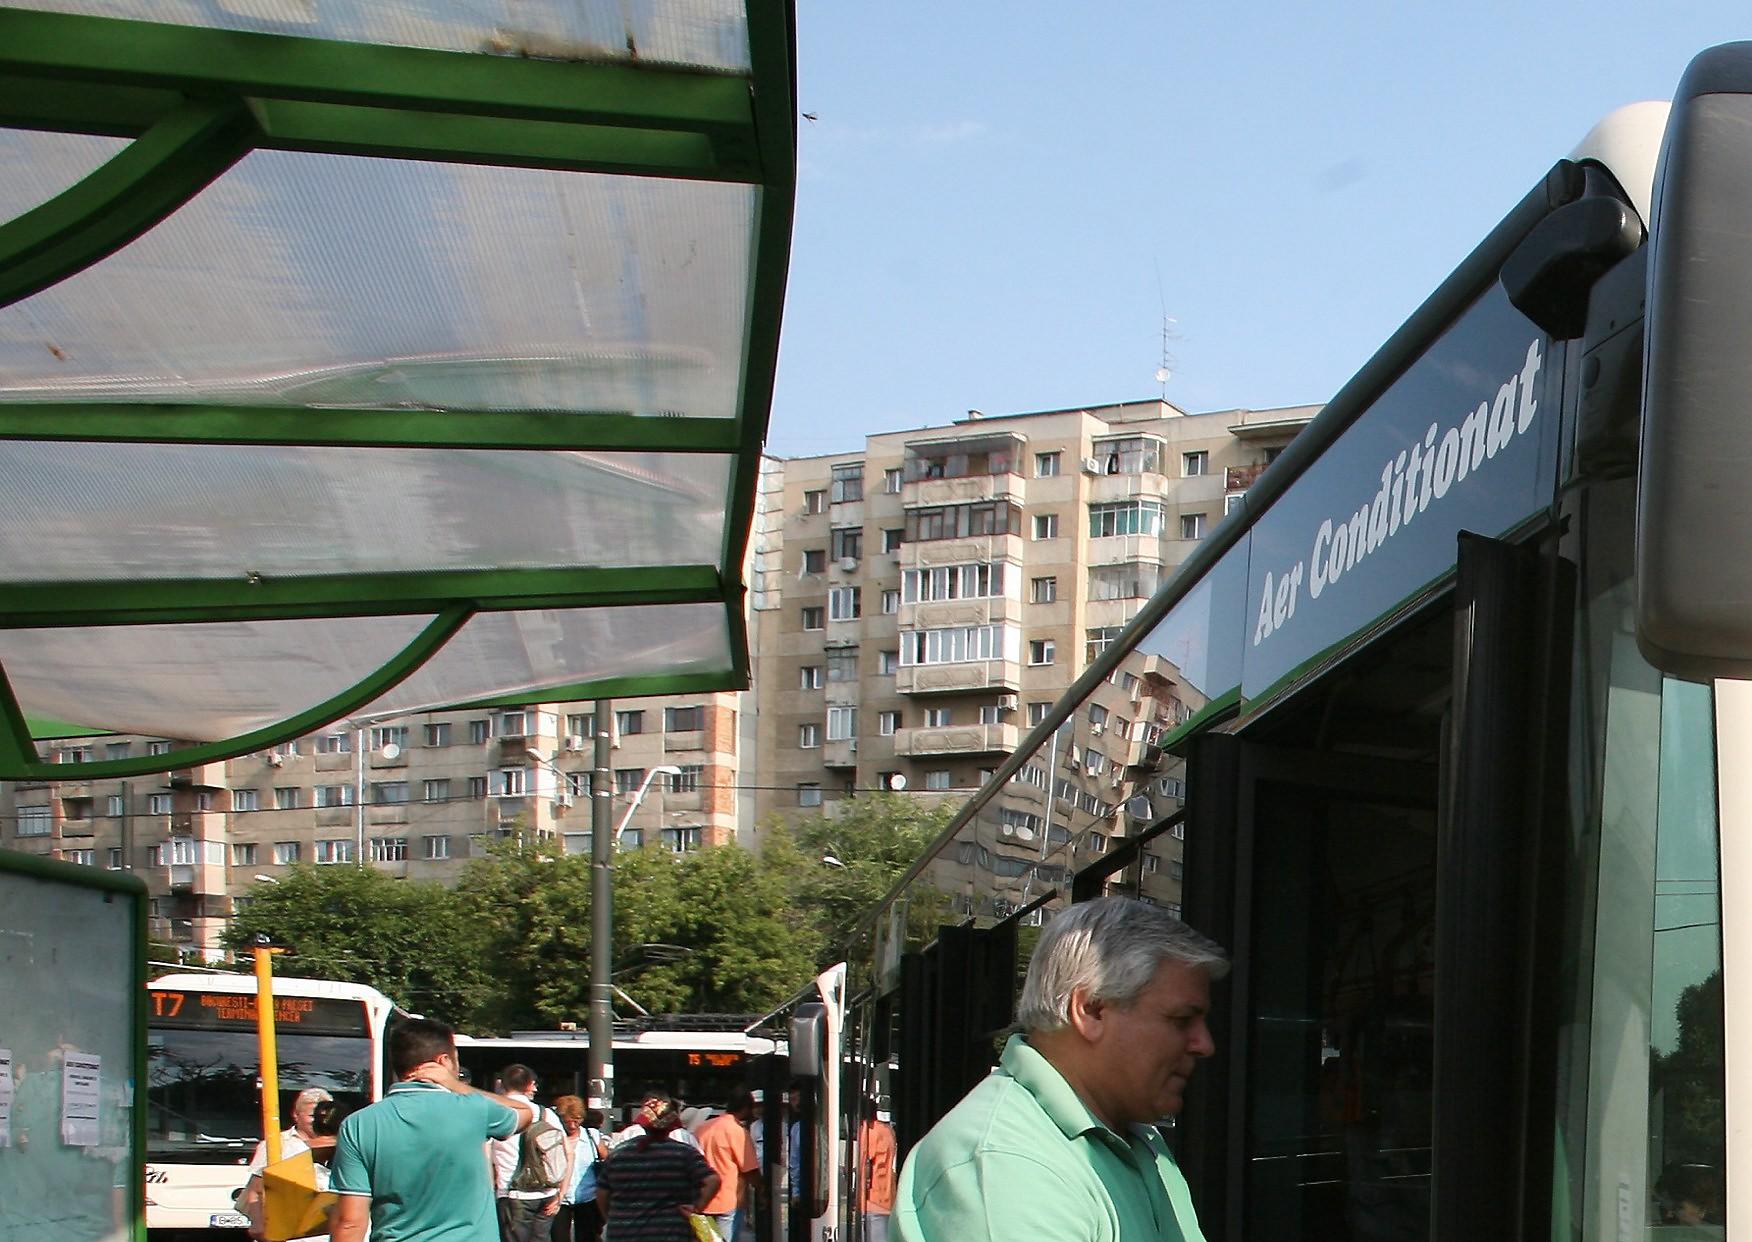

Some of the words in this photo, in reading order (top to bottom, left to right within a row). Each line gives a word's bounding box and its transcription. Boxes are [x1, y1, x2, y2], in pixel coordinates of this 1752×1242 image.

[1253, 561, 1303, 647] Aer
[1310, 338, 1543, 600] Conditionat
[151, 992, 184, 1017] T7
